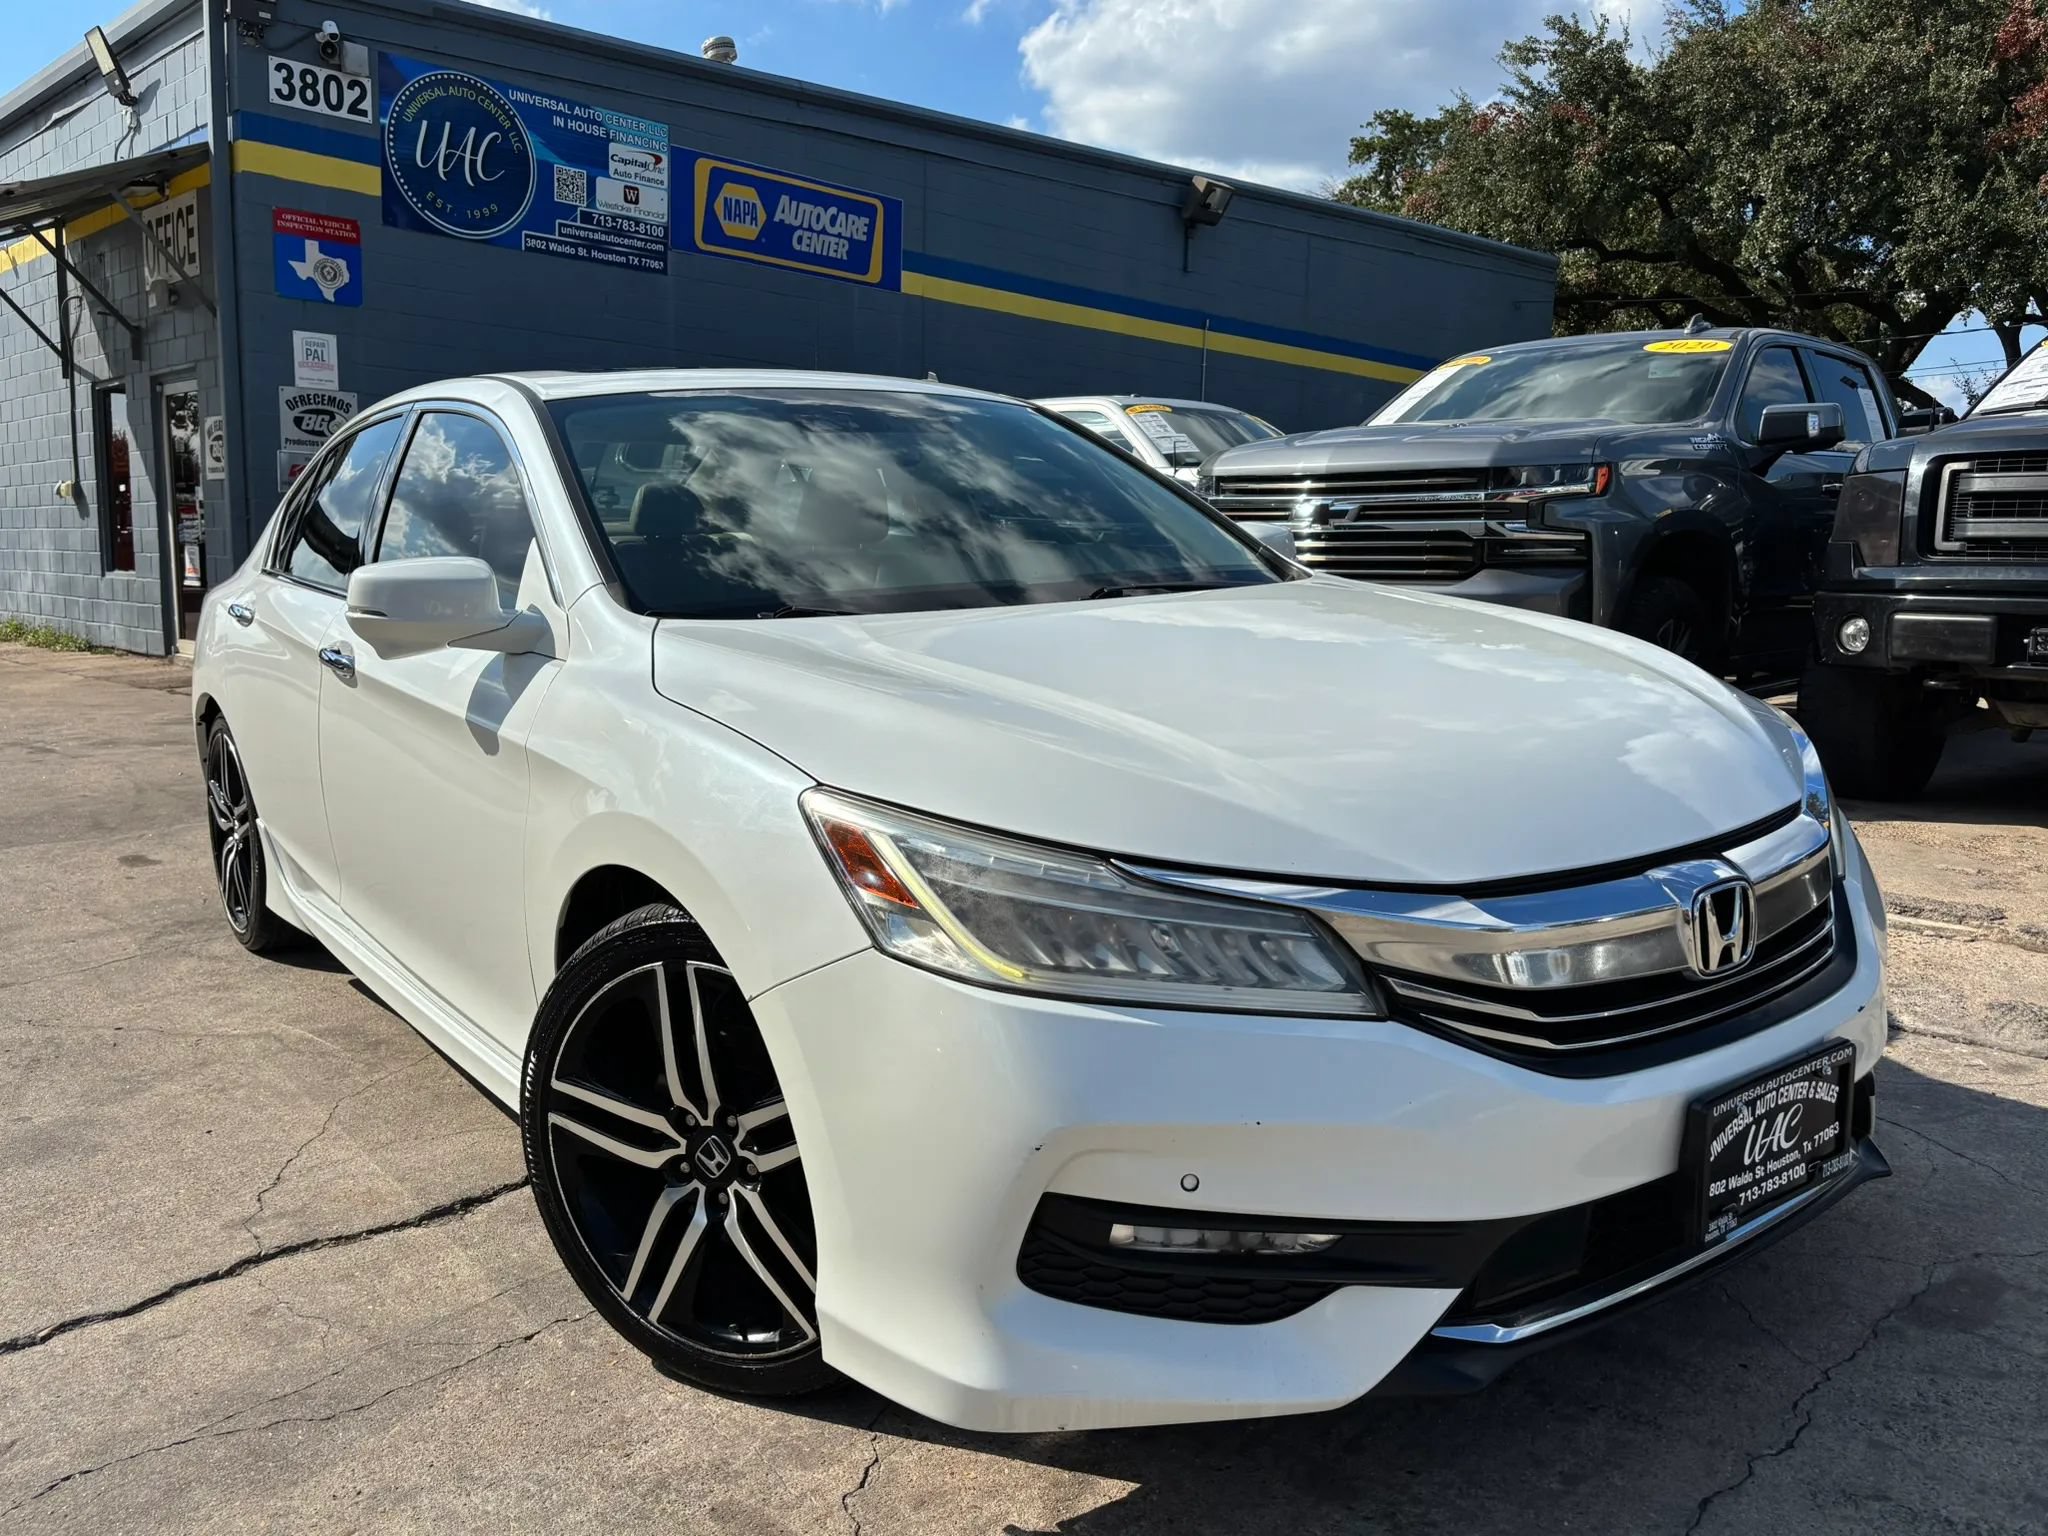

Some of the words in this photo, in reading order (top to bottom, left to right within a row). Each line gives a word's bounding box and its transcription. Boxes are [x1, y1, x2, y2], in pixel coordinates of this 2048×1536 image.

[274, 62, 368, 118] 3802
[403, 86, 447, 123] UNIVERSAL
[448, 86, 476, 101] AUTO
[477, 95, 511, 130] CENTER
[509, 89, 571, 114] UNIVERSAL
[574, 106, 602, 121] AUTO
[605, 114, 646, 131] CENTER
[648, 125, 668, 137] LLC
[553, 115, 565, 128] IN
[568, 120, 607, 138] HOUSE
[609, 130, 668, 151] FINANCING
[416, 120, 505, 187] UAC
[613, 168, 632, 179] Auto
[634, 172, 665, 186] Finance
[426, 191, 457, 217] EST.
[467, 203, 498, 219] 1999
[598, 199, 632, 214] Westlake
[625, 188, 638, 203] W
[282, 213, 318, 225] OFFICIAL
[319, 219, 352, 230] VEHICLE
[592, 213, 665, 238] 713-783-8100
[723, 196, 758, 228] NAPA
[145, 204, 197, 279] OFFICE
[277, 220, 324, 232] INSPECTION
[325, 228, 357, 239] STATION
[561, 225, 665, 252] universalautocenter.com
[792, 229, 849, 260] CENTER
[525, 237, 546, 250] 3802
[548, 241, 575, 255] Waldo
[591, 249, 626, 264] Houston
[628, 255, 640, 266] TX
[304, 340, 326, 349] REPAIR
[305, 348, 326, 362] PAL
[284, 392, 352, 415] OFRECEMOS
[301, 413, 330, 432] BG
[1713, 1046, 1853, 1116] UNIVERSALAUTOCENTER.COM
[1755, 1090, 1777, 1118] AUTO
[1778, 1081, 1809, 1104] CENTER
[1808, 1081, 1816, 1099] &
[1815, 1081, 1839, 1104] SALES
[1744, 1103, 1803, 1165] UAC
[1728, 1170, 1753, 1190] Waldo
[1755, 1165, 1765, 1180] St
[1767, 1149, 1801, 1174] Houston,
[1803, 1141, 1812, 1155] Tx
[1814, 1121, 1839, 1148] 77063
[1739, 1162, 1806, 1206] 713-783-8100
